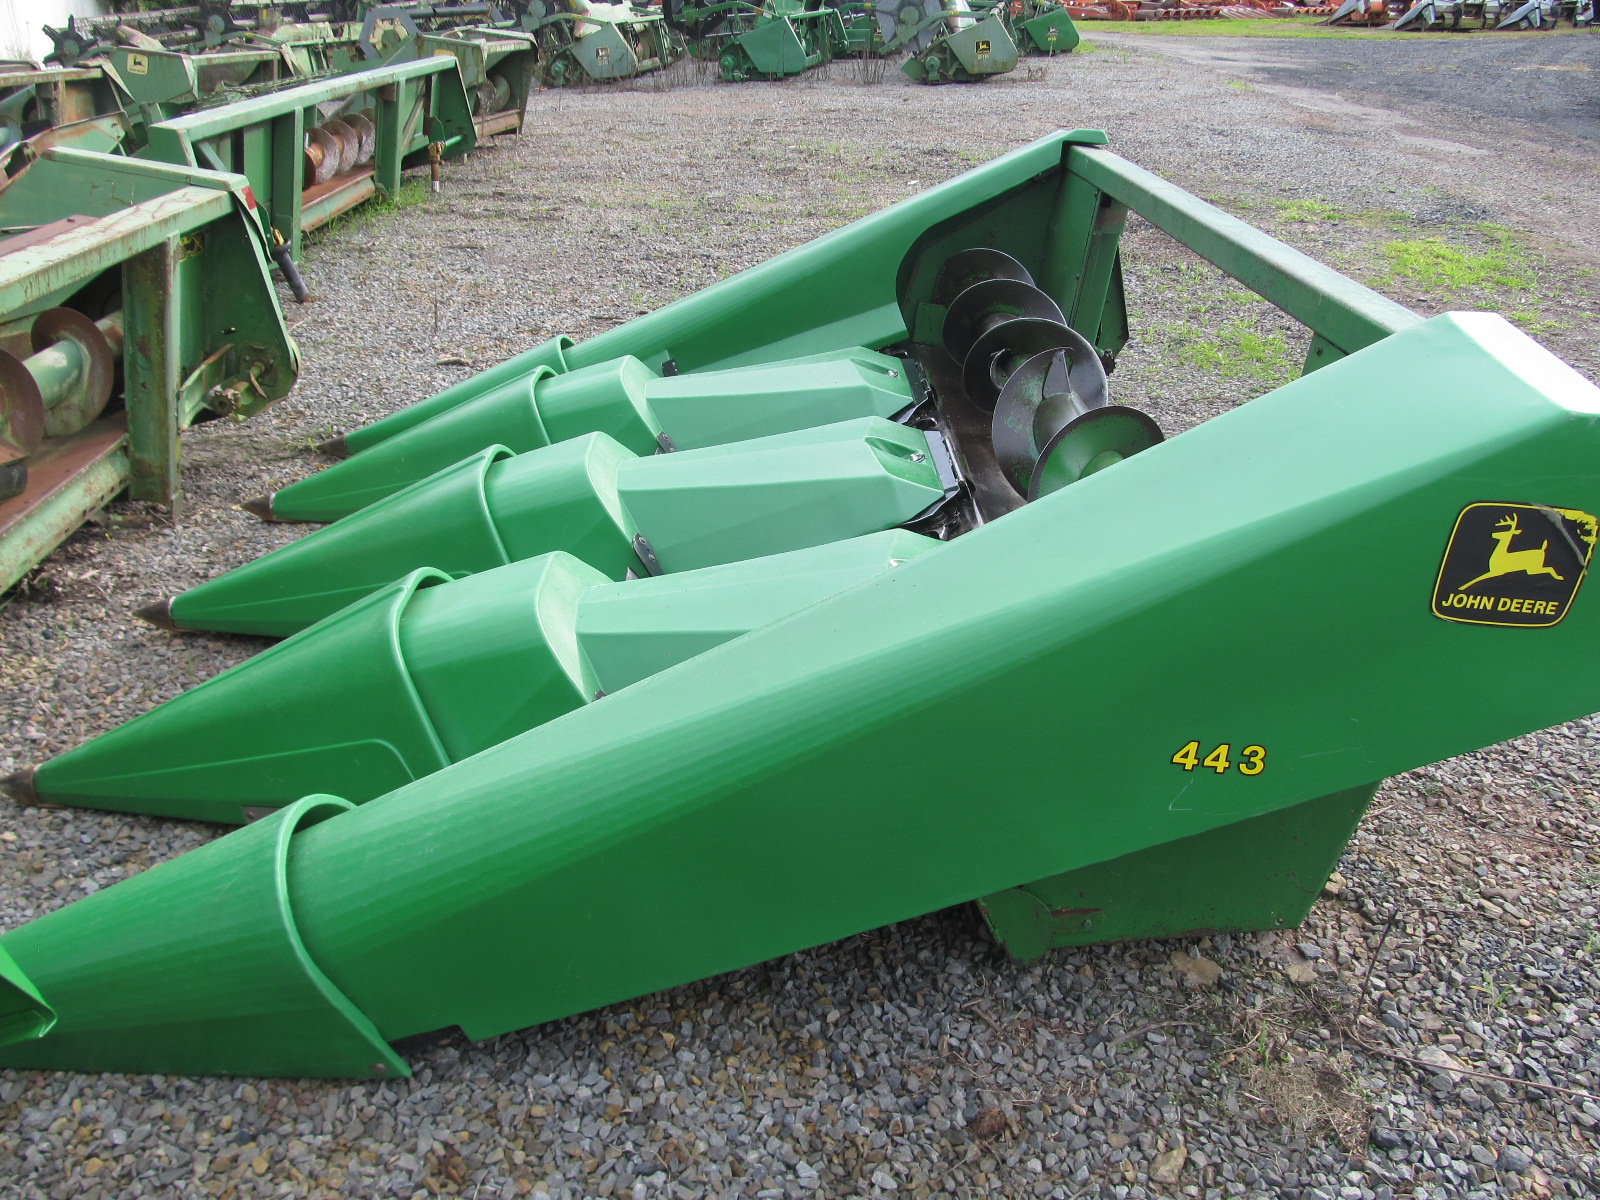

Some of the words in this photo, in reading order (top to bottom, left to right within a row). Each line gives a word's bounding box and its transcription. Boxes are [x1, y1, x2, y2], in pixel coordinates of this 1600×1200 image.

[1442, 593, 1494, 610] JOHN
[1497, 598, 1558, 615] DEERE
[1170, 740, 1267, 776] 443
